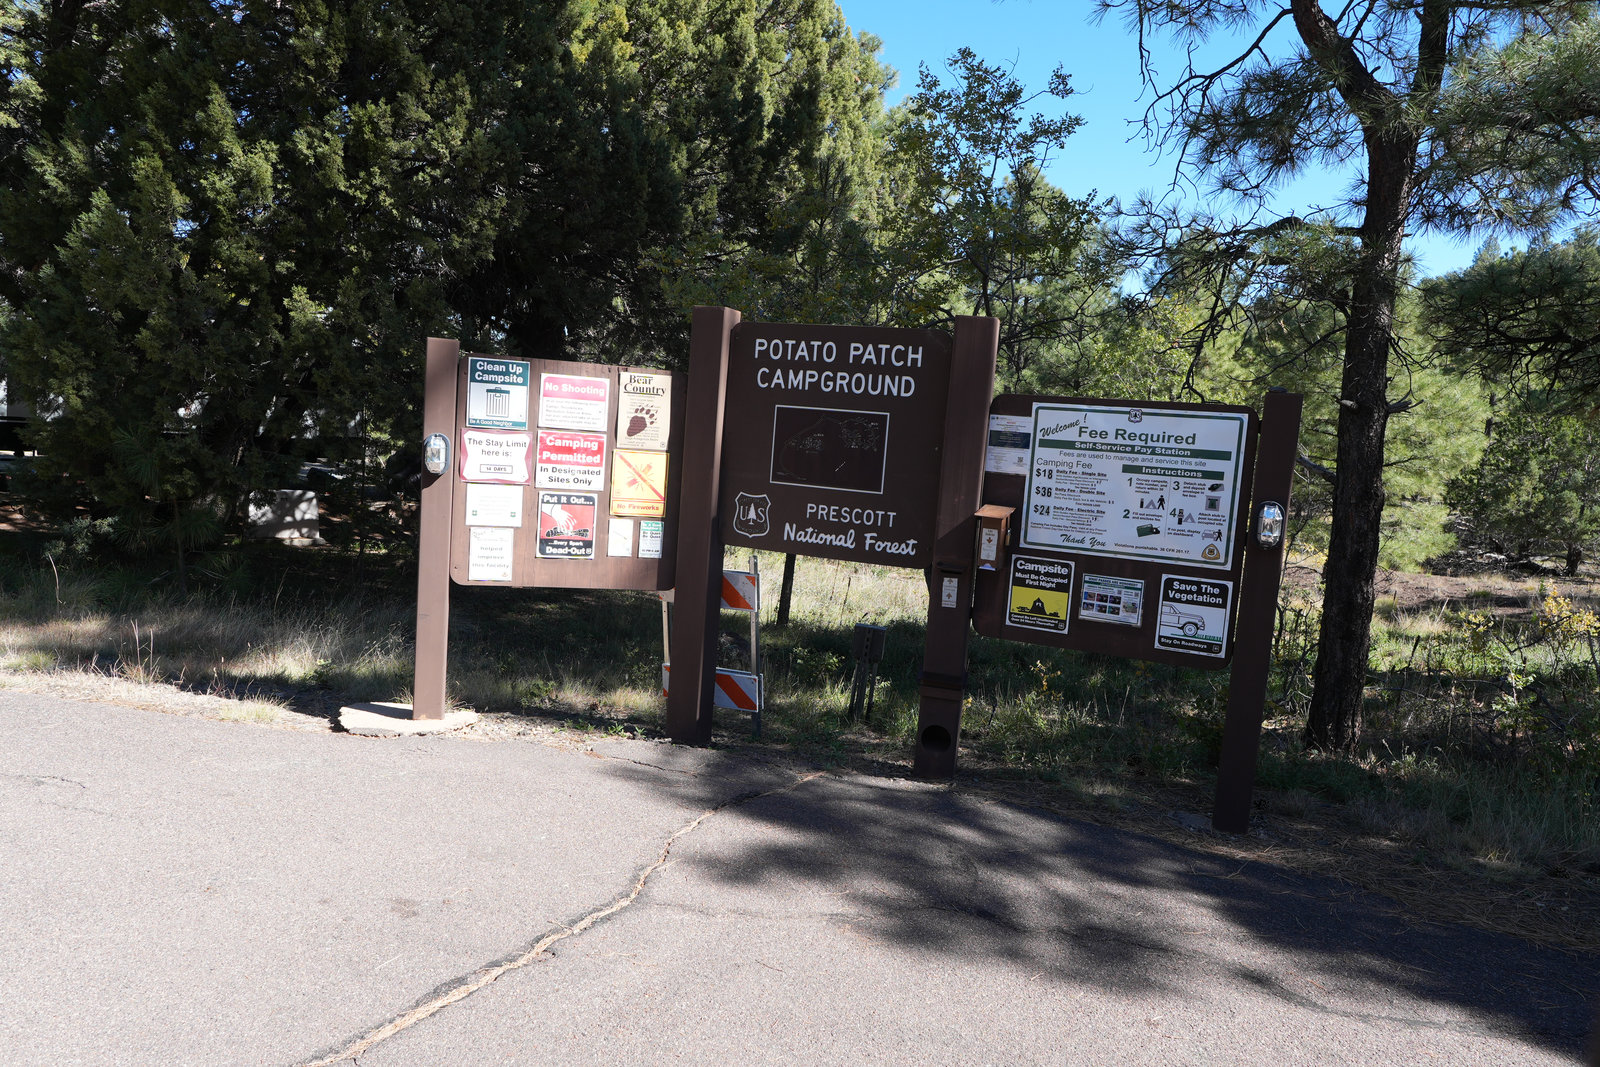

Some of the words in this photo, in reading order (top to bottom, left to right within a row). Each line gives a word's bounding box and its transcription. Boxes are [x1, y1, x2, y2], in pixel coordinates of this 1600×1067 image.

[754, 338, 837, 363] POTATO
[848, 342, 923, 368] PATCH
[476, 361, 506, 372] Clean
[508, 363, 523, 375] Up
[474, 371, 524, 384] Campsite
[629, 374, 653, 385] Bear
[756, 367, 916, 397] CAMPGROUND
[544, 381, 559, 391] No
[561, 383, 605, 397] Shooting
[623, 382, 667, 396] Country
[1078, 425, 1109, 439] Fee
[1114, 427, 1197, 445] Required
[467, 437, 483, 446] The
[485, 438, 504, 448] Stay
[506, 440, 527, 448] Limit
[546, 436, 599, 451] Camping
[1074, 441, 1132, 452] Self-Service
[1134, 445, 1153, 455] Pay
[1154, 446, 1191, 456] Station
[542, 450, 601, 463] Permitted
[1059, 450, 1075, 458] Fees
[1087, 451, 1103, 459] used
[1113, 453, 1140, 463] manage
[1140, 456, 1154, 464] and
[1155, 457, 1179, 465] service
[1194, 459, 1207, 467] site
[1036, 457, 1074, 469] Camping
[1075, 460, 1093, 470] Fee
[551, 466, 601, 476] Designated
[1035, 467, 1053, 479] $18
[1142, 466, 1203, 477] Instructions
[548, 476, 570, 484] Sites
[573, 477, 592, 486] Only
[1127, 477, 1133, 487] 1
[1172, 480, 1180, 490] 3
[1034, 485, 1053, 497] $36
[543, 495, 558, 503] Put
[628, 503, 660, 511] Fireworks
[1033, 504, 1050, 516] $24
[1122, 508, 1130, 519] 2
[1169, 507, 1177, 518] 4
[806, 503, 897, 528] PRESCOTT
[783, 522, 856, 549] National
[863, 533, 918, 556] Forest
[1060, 533, 1086, 545] Thank
[1089, 536, 1106, 548] You
[545, 546, 586, 554] Dead-Out
[1016, 560, 1069, 575] Campsite
[1015, 571, 1029, 579] Must
[1039, 574, 1068, 584] Occupied
[1039, 580, 1056, 588] Night
[1172, 581, 1198, 592] Save
[1200, 584, 1220, 594] The
[1168, 589, 1223, 604] Vegetation
[1181, 640, 1208, 649] Roadways
